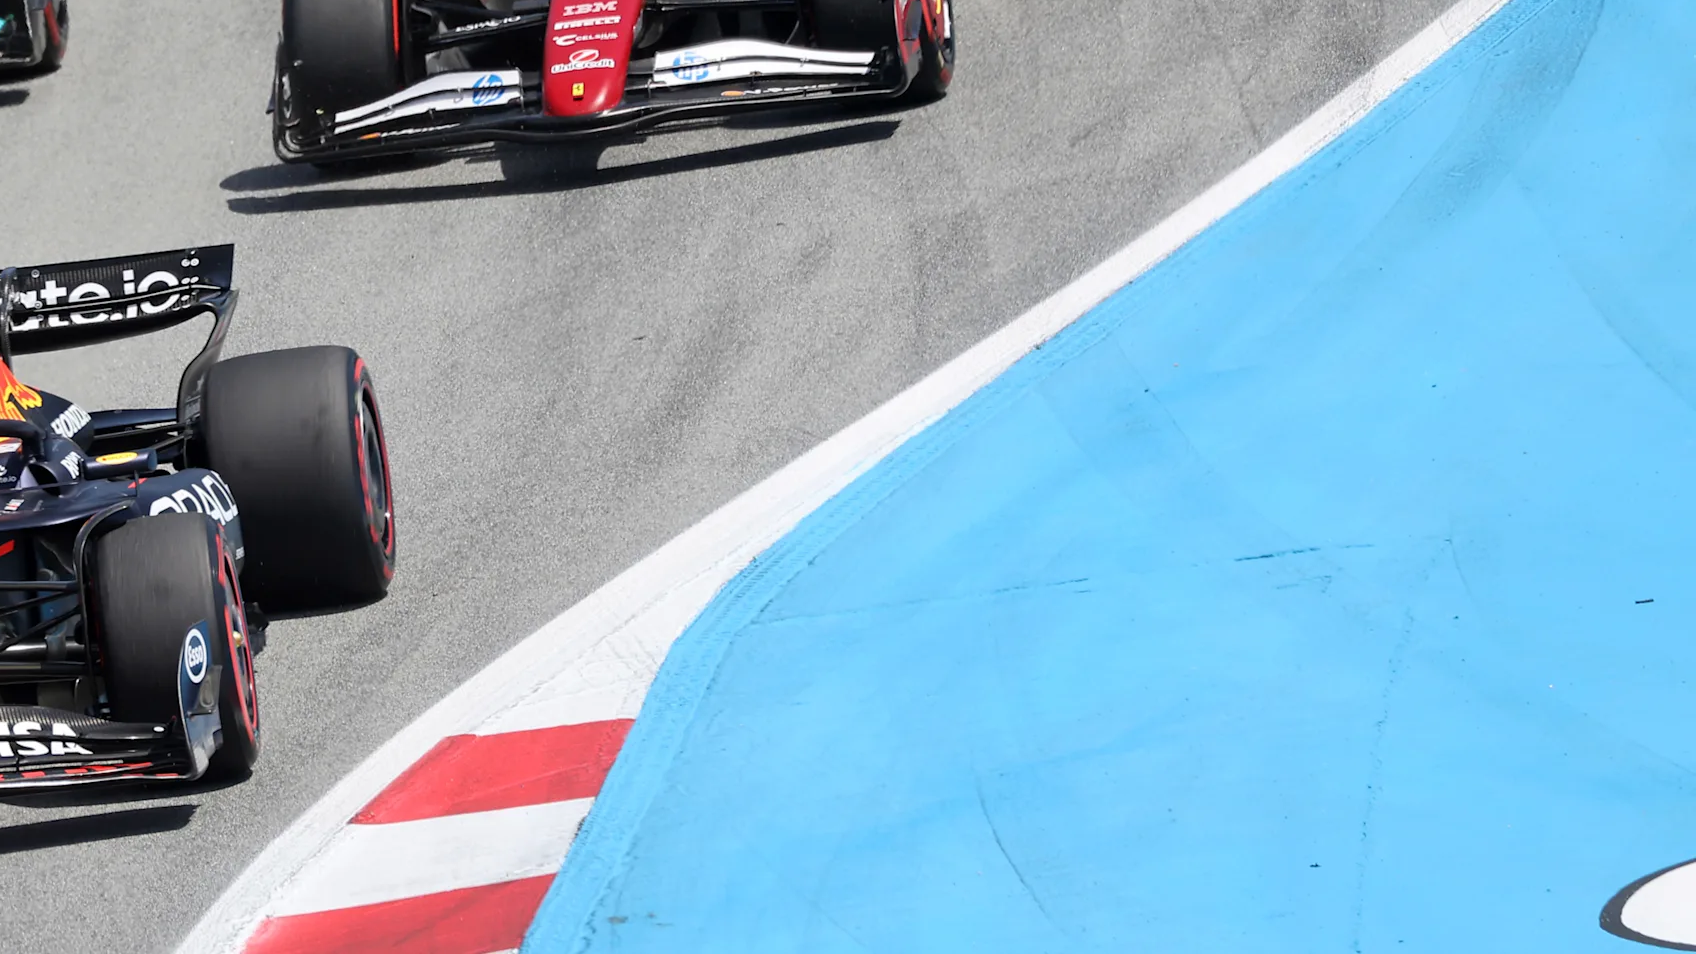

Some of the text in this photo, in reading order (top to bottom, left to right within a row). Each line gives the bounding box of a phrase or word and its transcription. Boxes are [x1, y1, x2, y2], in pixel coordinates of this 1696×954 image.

[562, 0, 619, 17] IBM
[551, 58, 616, 75] UniCredit
[474, 74, 504, 105] hp
[51, 403, 92, 440] HONDA
